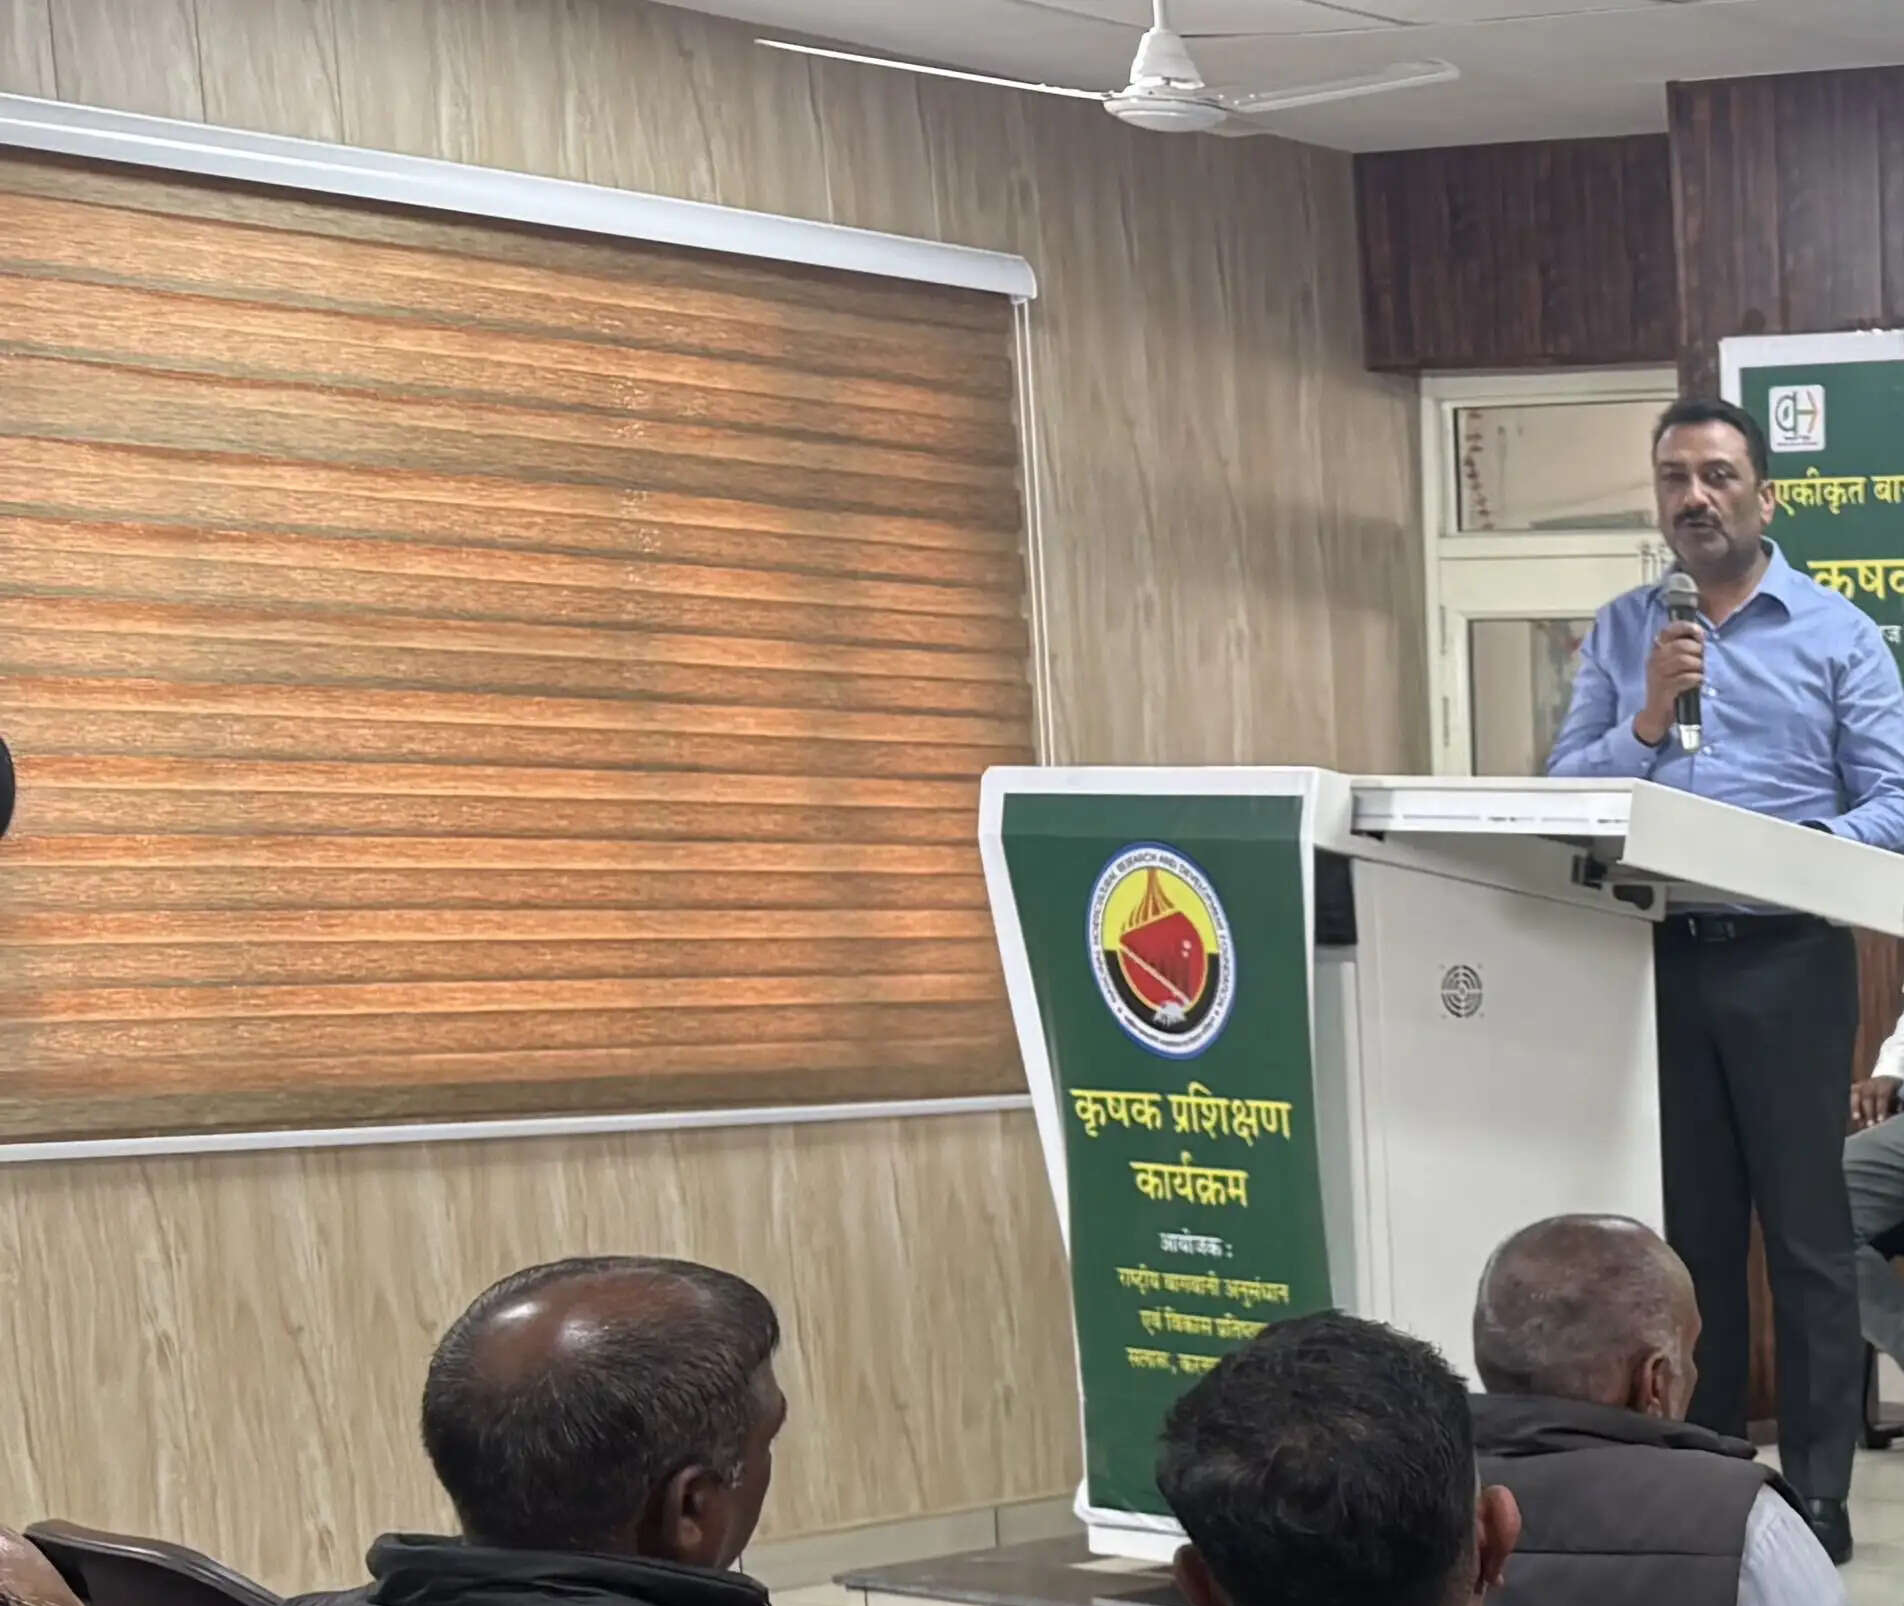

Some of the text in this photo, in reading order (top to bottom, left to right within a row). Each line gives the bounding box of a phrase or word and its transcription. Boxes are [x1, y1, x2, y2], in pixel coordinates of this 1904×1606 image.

[1774, 467, 1867, 516] एकीकृत
[1069, 1081, 1293, 1147] कृषक प्रशिक्षण
[1129, 1151, 1248, 1208] कार्यक्रम
